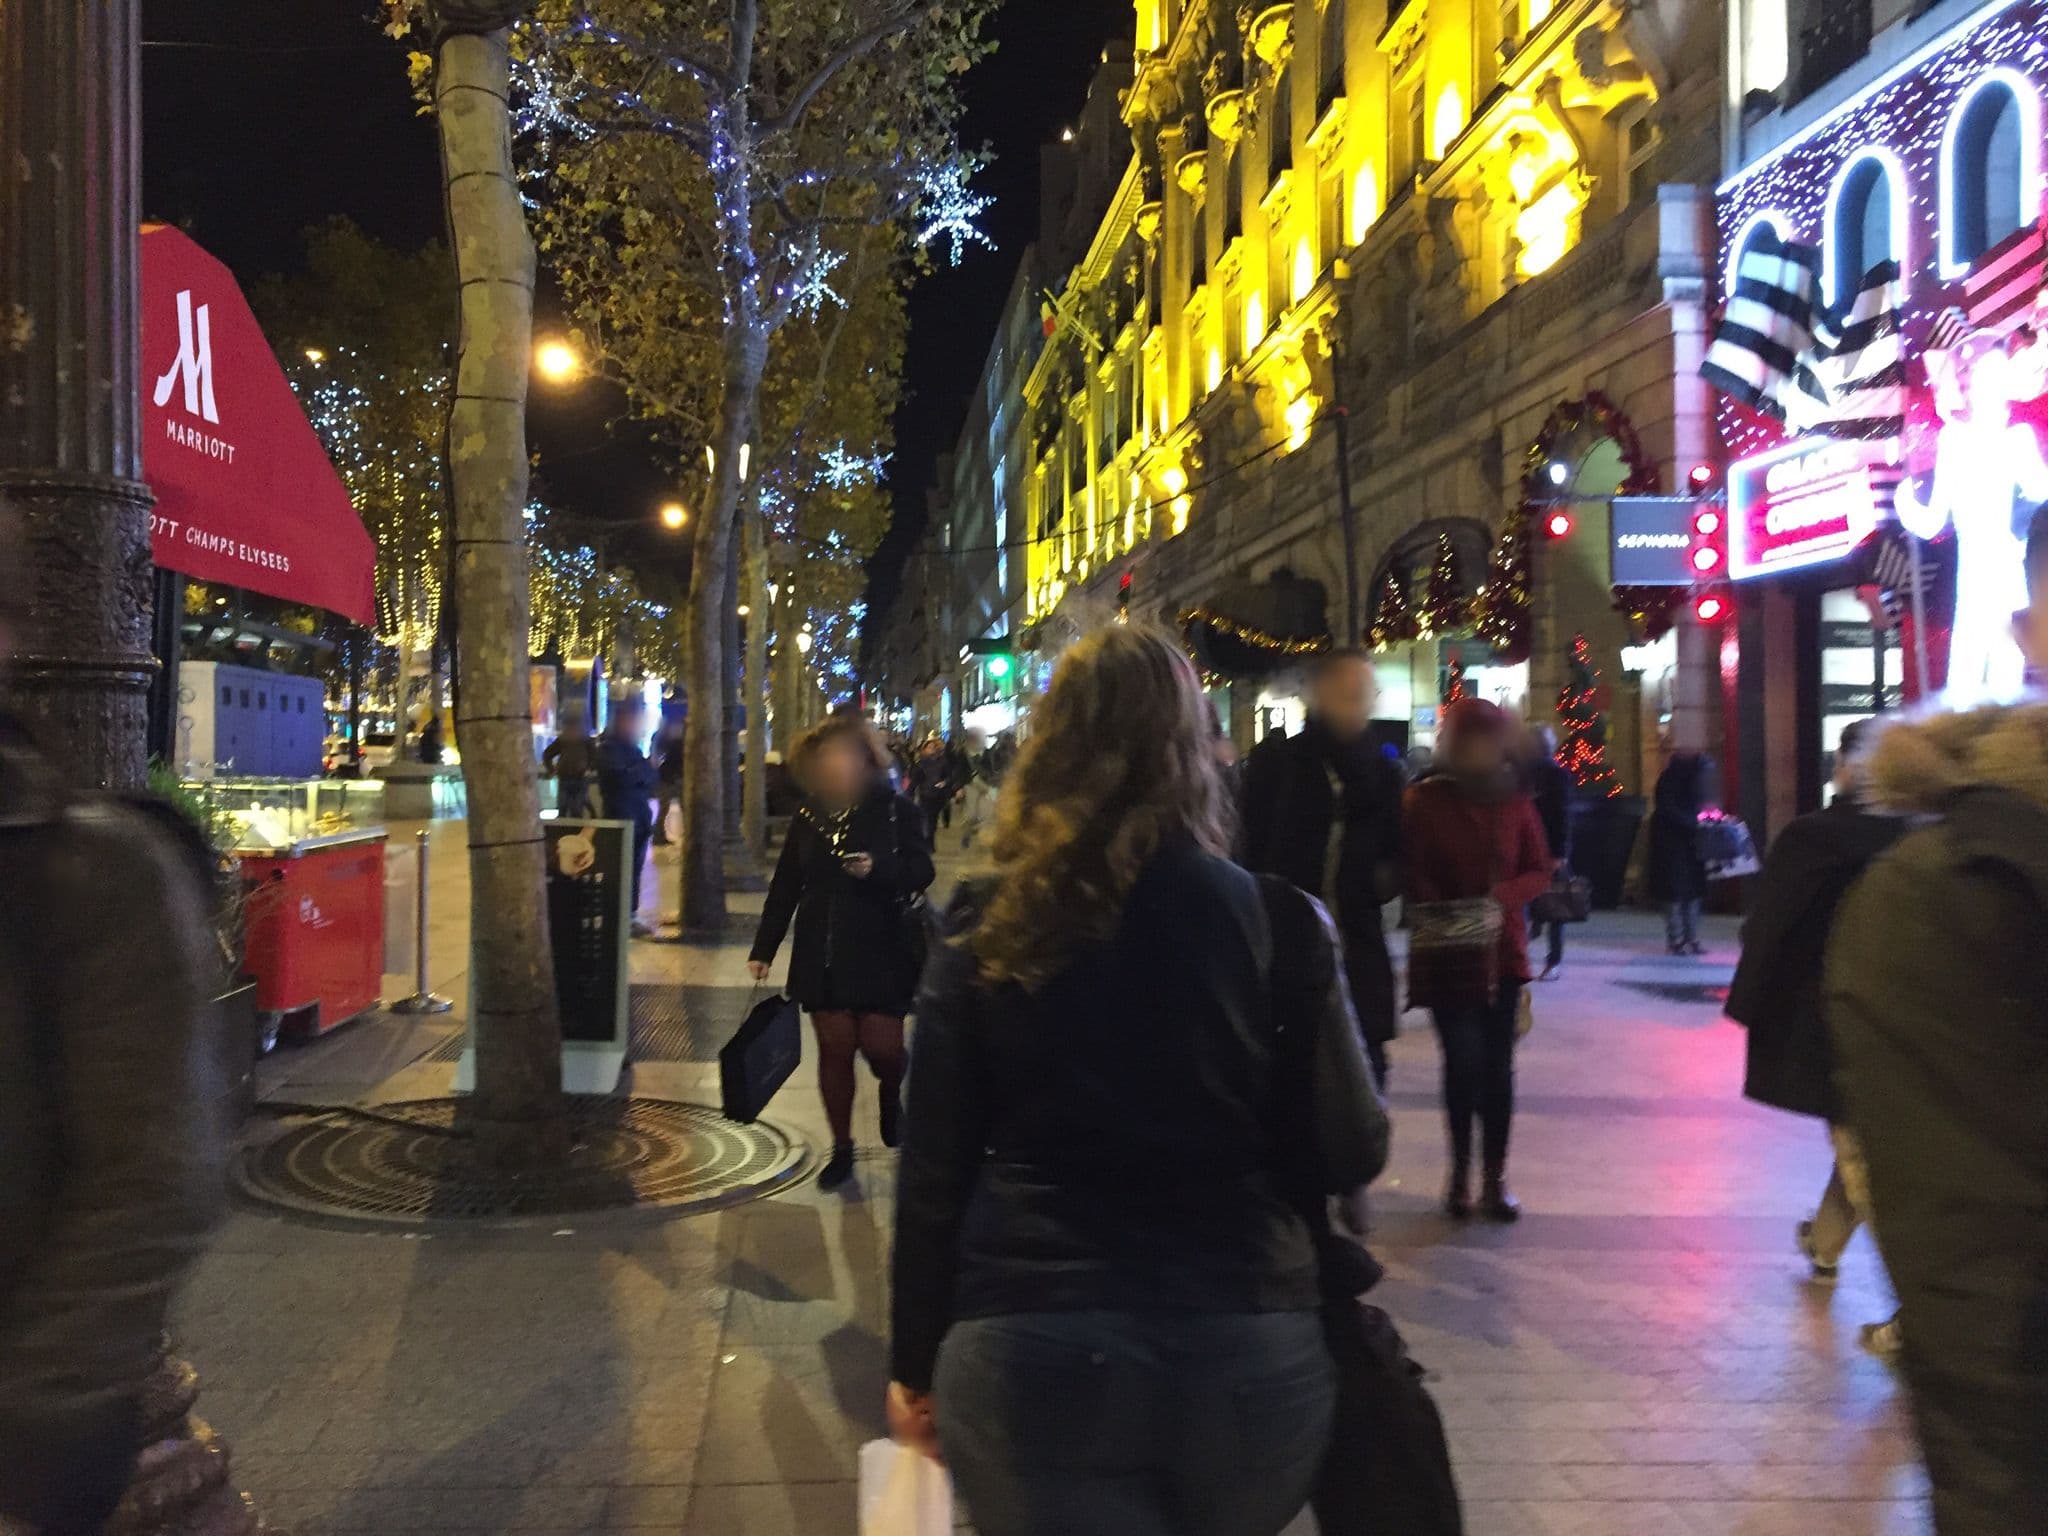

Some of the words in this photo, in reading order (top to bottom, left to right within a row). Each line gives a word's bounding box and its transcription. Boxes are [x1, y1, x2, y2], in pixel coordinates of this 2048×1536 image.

[167, 419, 235, 464] MARRIOTT
[185, 526, 235, 556] CHAMPS
[239, 544, 290, 572] ELYSEES
[1618, 534, 1690, 548] SEPHORA
